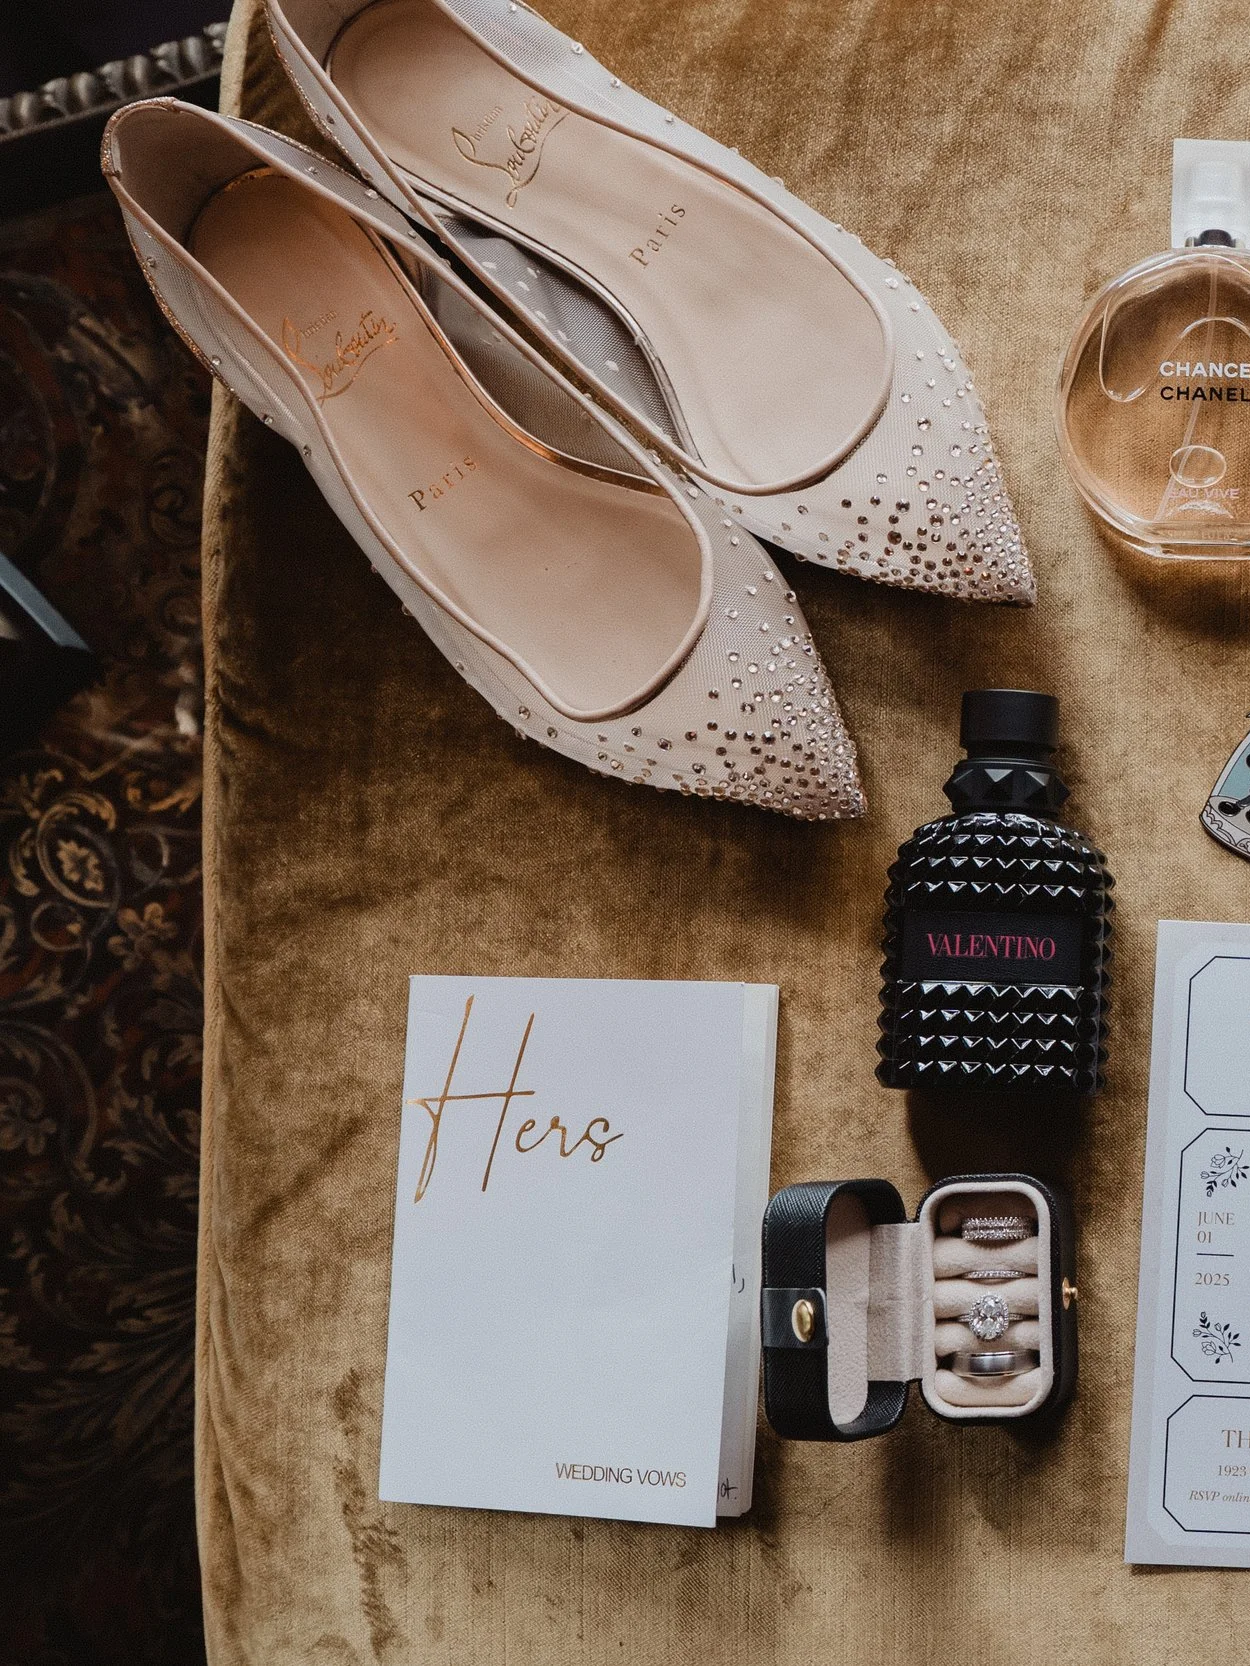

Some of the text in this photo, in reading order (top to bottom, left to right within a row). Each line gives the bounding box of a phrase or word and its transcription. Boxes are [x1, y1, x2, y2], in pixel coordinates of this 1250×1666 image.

[627, 203, 686, 270] Paris
[408, 456, 477, 511] Paris
[1167, 488, 1240, 499] EAU VIVE
[927, 933, 1056, 961] VALENTINO
[405, 994, 624, 1204] Hers
[1197, 1211, 1236, 1227] JUNE
[1197, 1230, 1212, 1244] 01
[1195, 1271, 1230, 1287] 2025
[555, 1462, 688, 1488] WEDDING VOWS
[1217, 1464, 1247, 1477] 1923
[1189, 1489, 1221, 1502] RSVP
